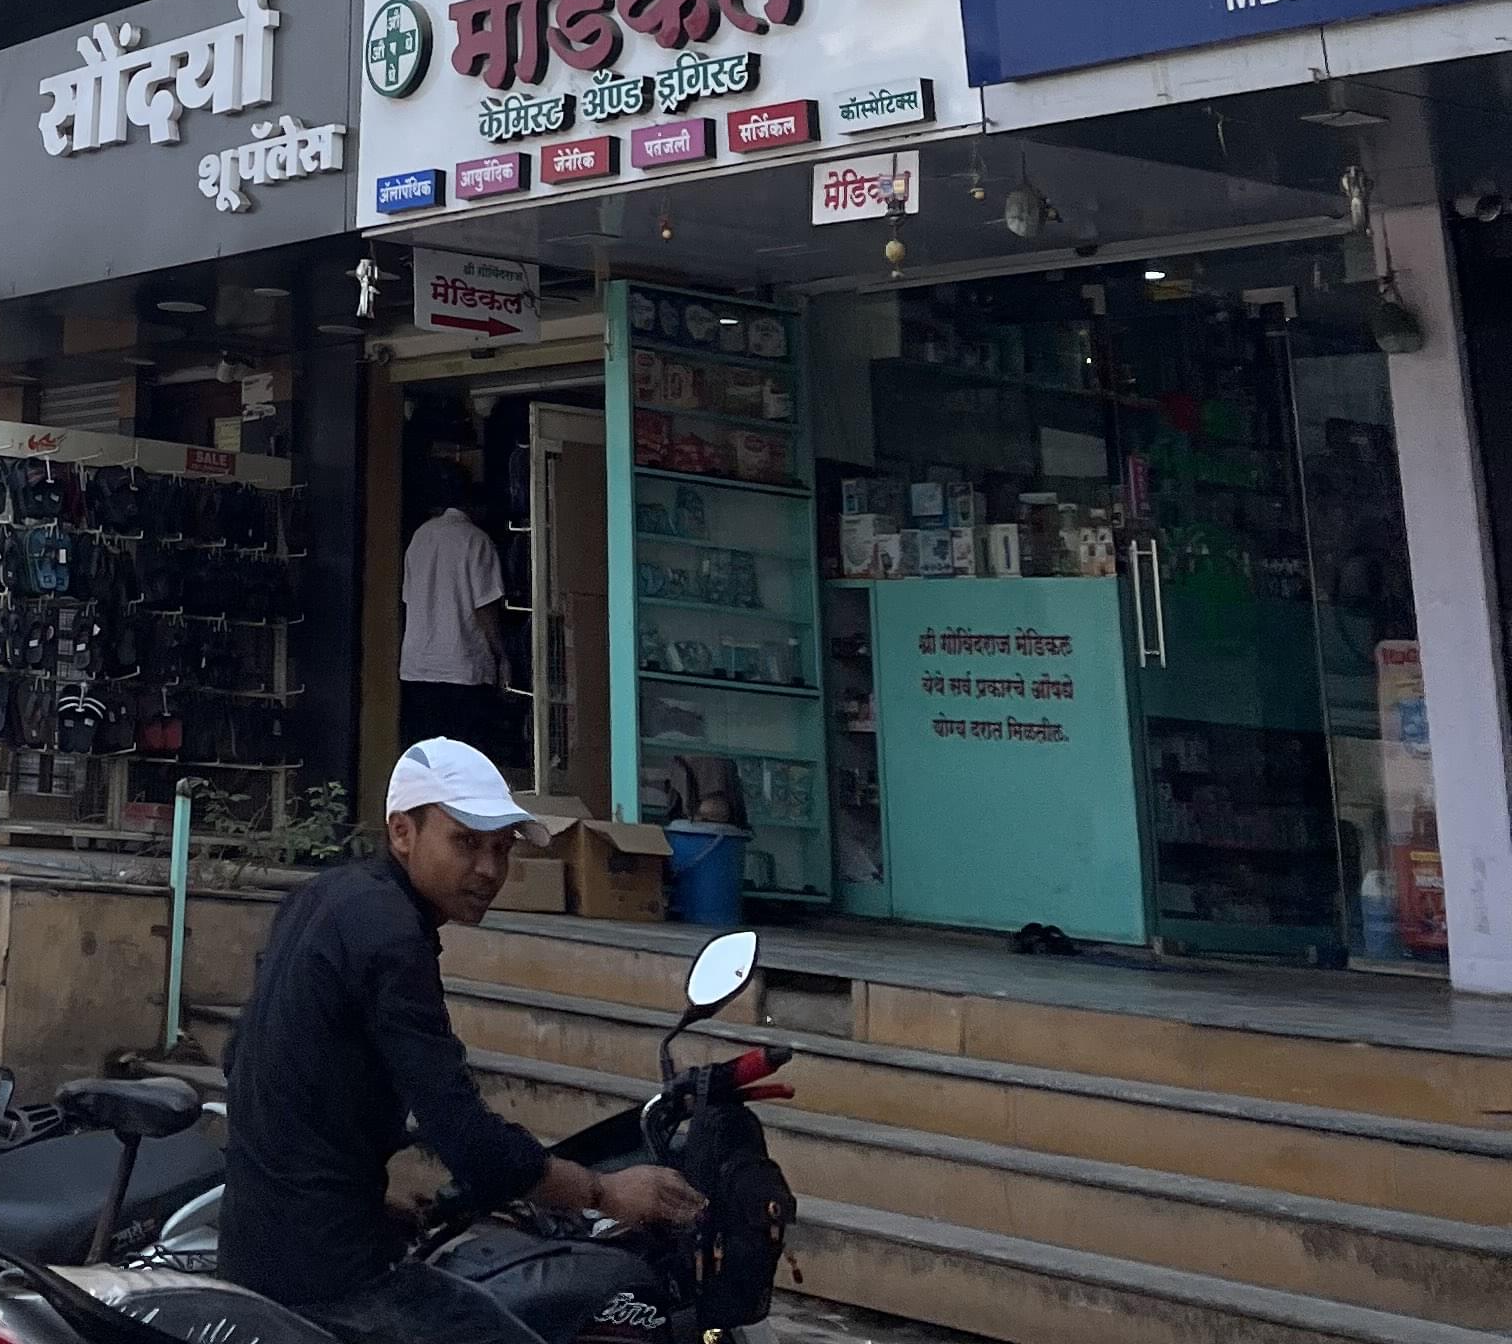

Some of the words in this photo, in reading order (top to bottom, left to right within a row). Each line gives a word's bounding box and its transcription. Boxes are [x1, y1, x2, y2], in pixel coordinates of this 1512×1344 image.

[478, 90, 568, 146] केमिस्ट
[656, 51, 752, 111] ड्रगिस्ट
[838, 88, 919, 122] कॉस्मेटिक्स
[644, 128, 691, 158] पतंजली
[737, 115, 797, 144] सर्जिकल
[431, 275, 524, 315] मेडिकल
[1015, 626, 1073, 657] मेडिकल
[975, 671, 1026, 700] प्रकारचे
[970, 720, 1003, 741] दरात
